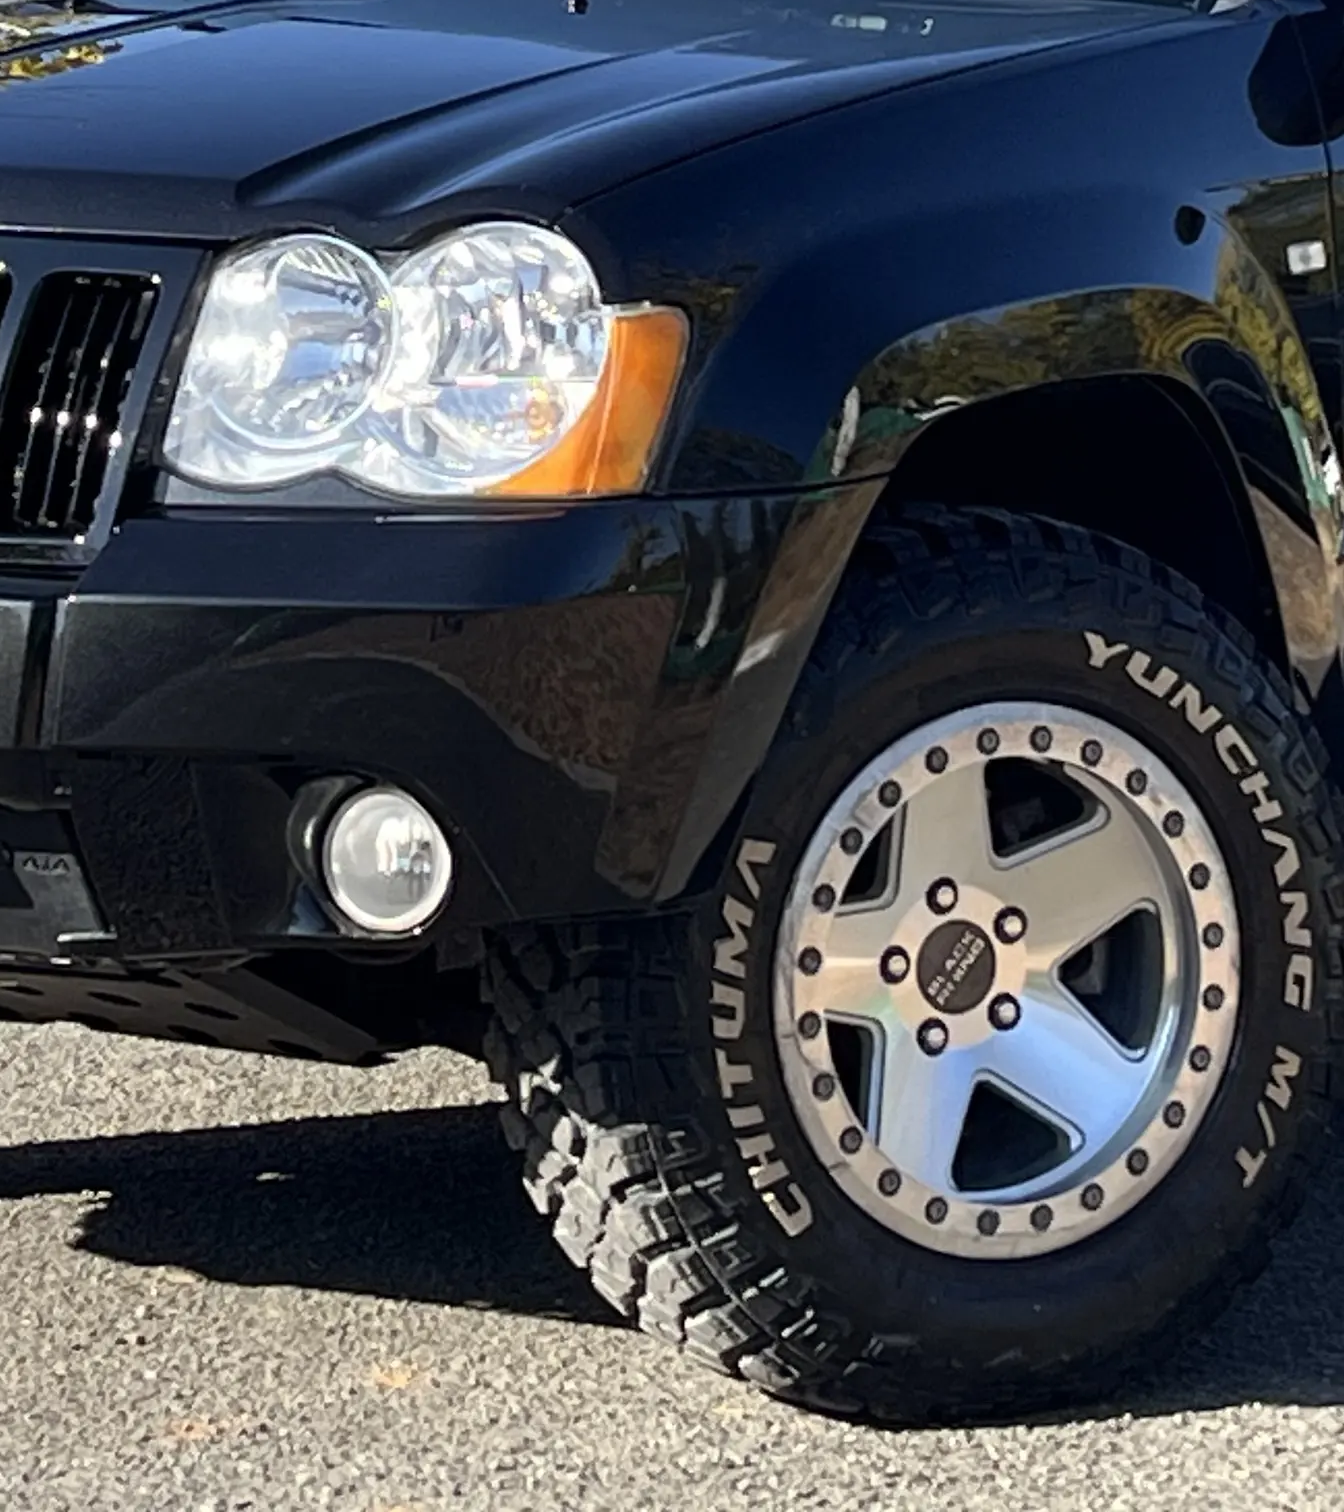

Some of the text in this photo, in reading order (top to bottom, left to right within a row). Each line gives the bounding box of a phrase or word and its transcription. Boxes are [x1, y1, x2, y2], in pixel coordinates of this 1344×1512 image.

[709, 838, 814, 1238] CHITUMA
[1084, 631, 1314, 1189] YUNCHANG M/T
